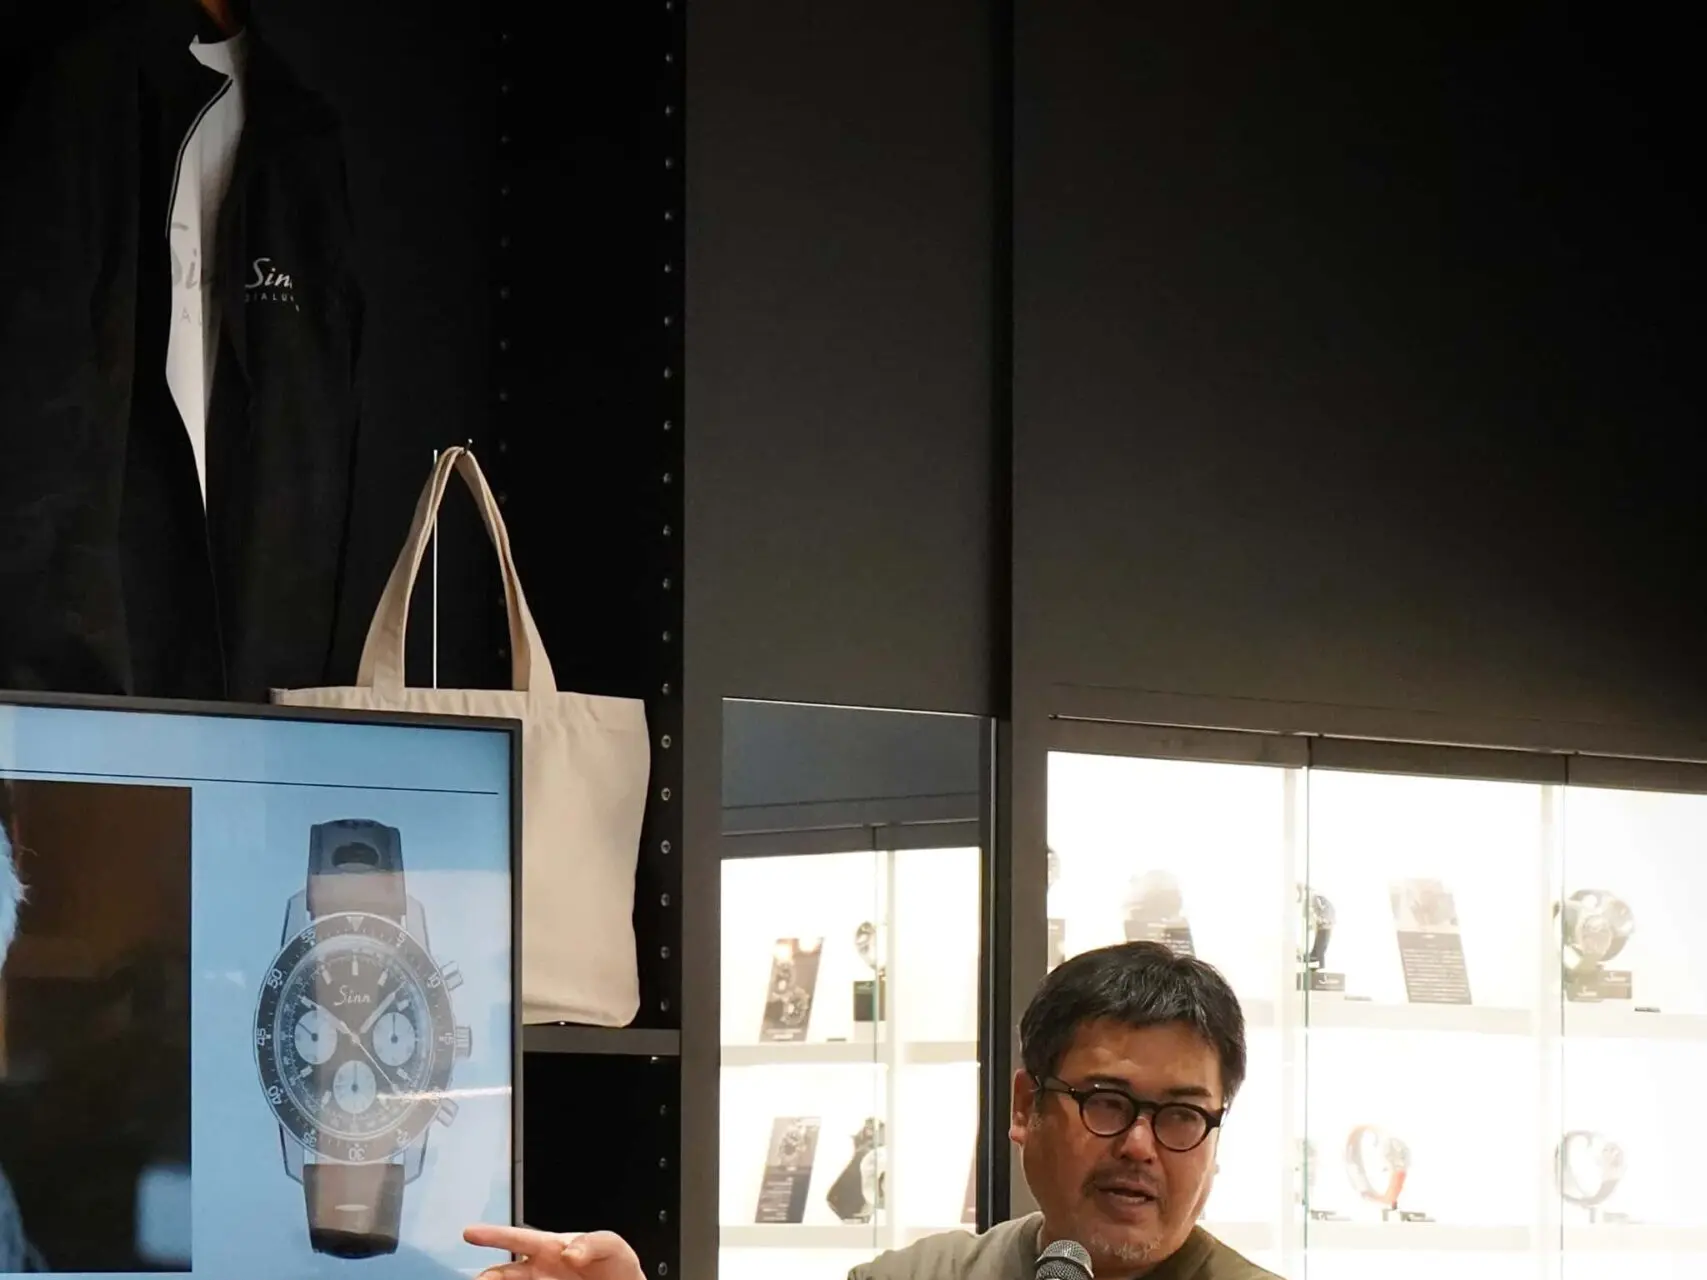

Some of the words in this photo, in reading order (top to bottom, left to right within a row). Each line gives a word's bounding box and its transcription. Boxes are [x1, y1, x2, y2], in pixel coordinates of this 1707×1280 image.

[245, 257, 293, 289] Sin
[267, 968, 283, 989] 50
[333, 984, 371, 1006] Sinn
[267, 1085, 282, 1105] 40
[348, 1146, 366, 1161] 30
